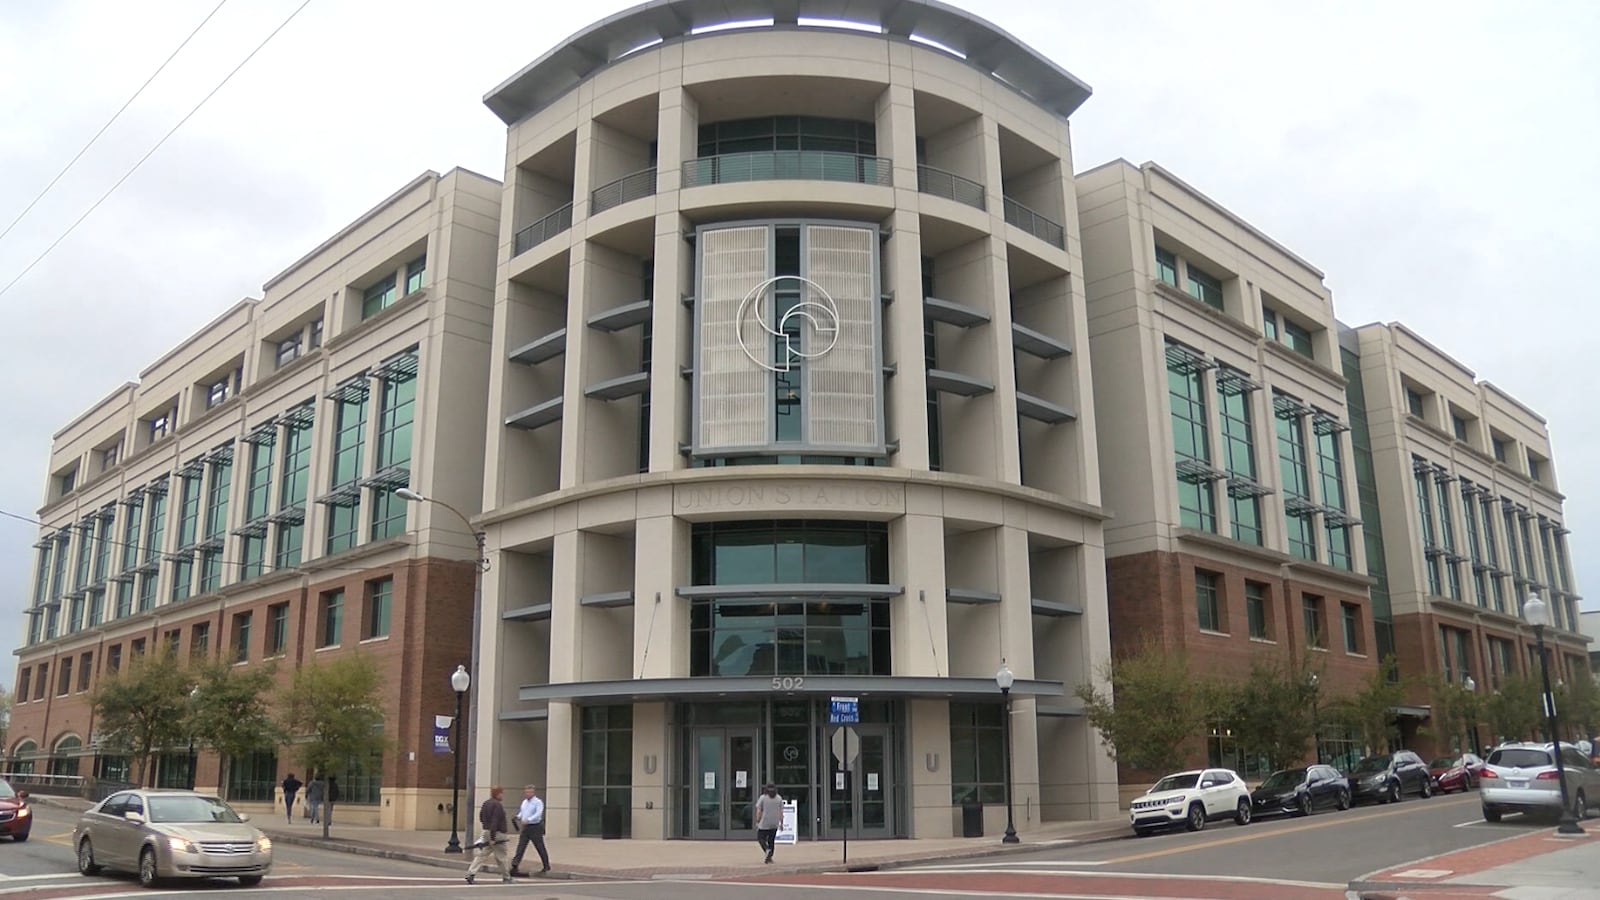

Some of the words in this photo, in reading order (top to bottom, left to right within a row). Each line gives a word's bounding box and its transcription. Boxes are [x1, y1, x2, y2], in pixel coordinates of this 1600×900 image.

[677, 486, 765, 508] UNION
[775, 485, 901, 506] STATION
[772, 677, 804, 690] 502
